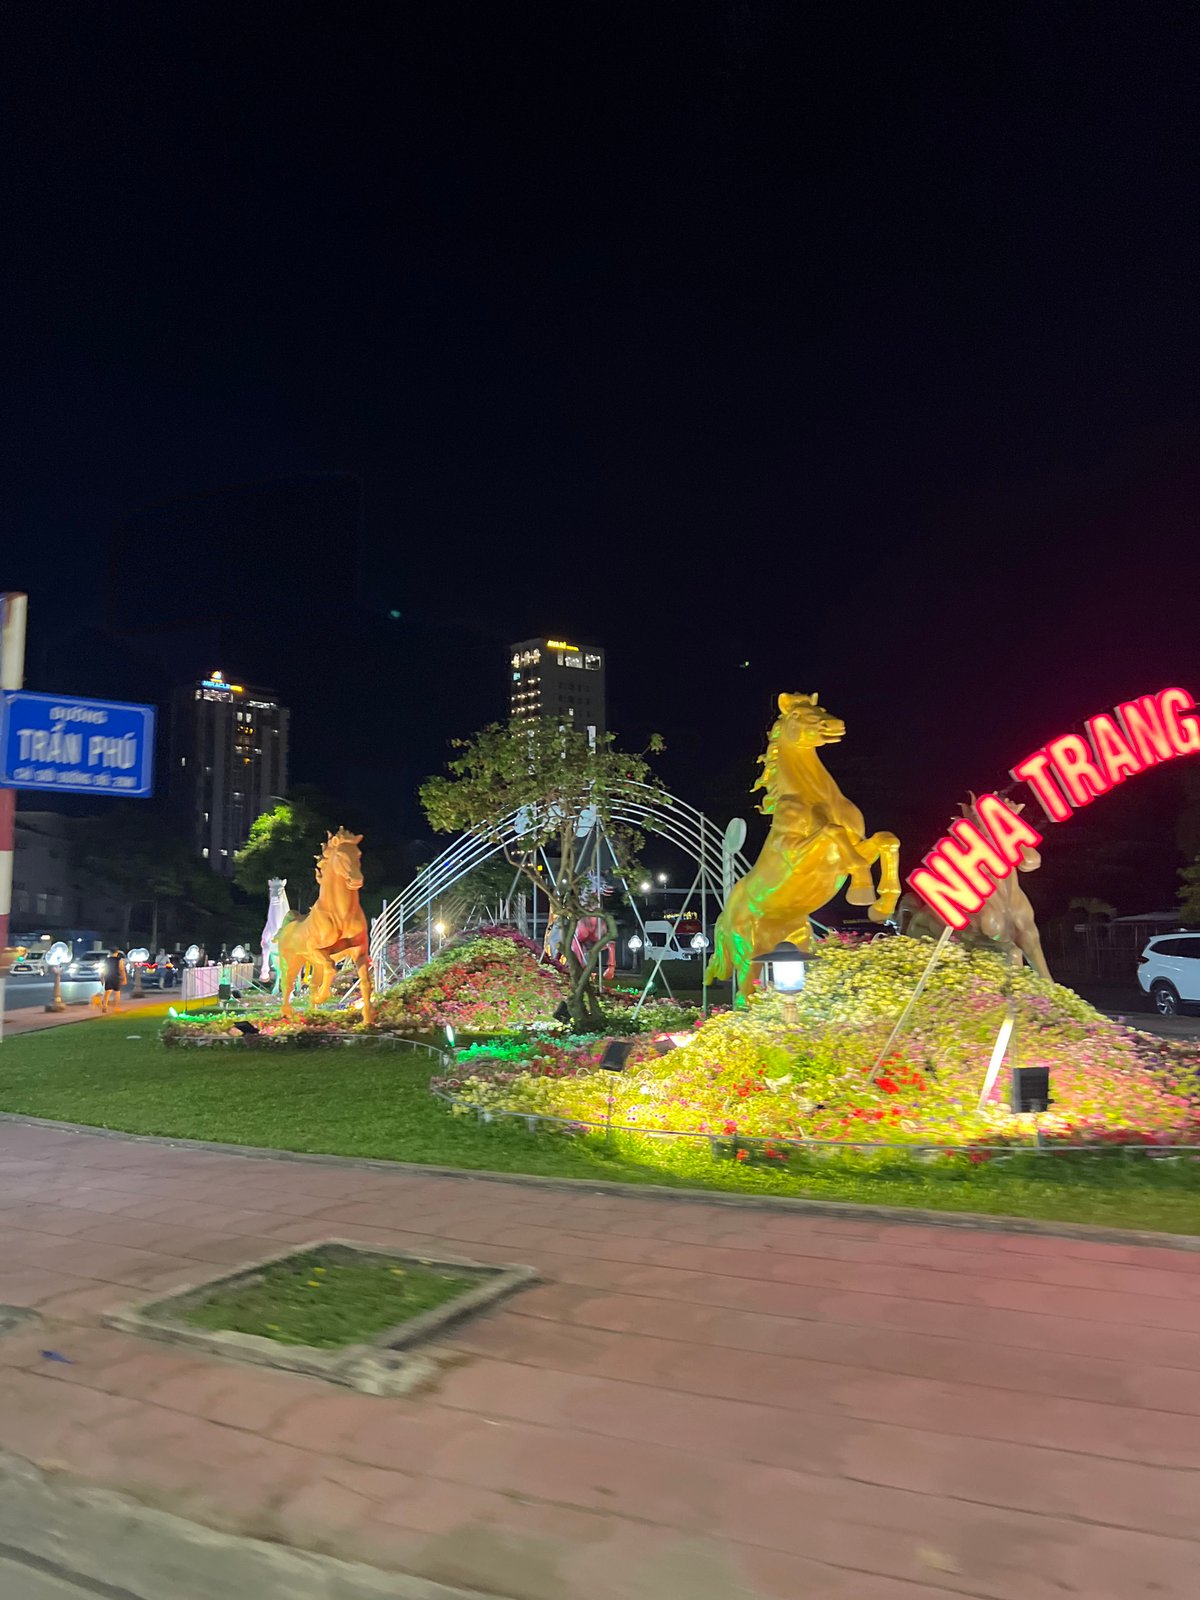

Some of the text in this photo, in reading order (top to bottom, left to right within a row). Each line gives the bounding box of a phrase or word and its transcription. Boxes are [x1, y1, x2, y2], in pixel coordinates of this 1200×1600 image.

[88, 732, 137, 769] PHÚ
[906, 687, 1200, 930] NHA TRANG
